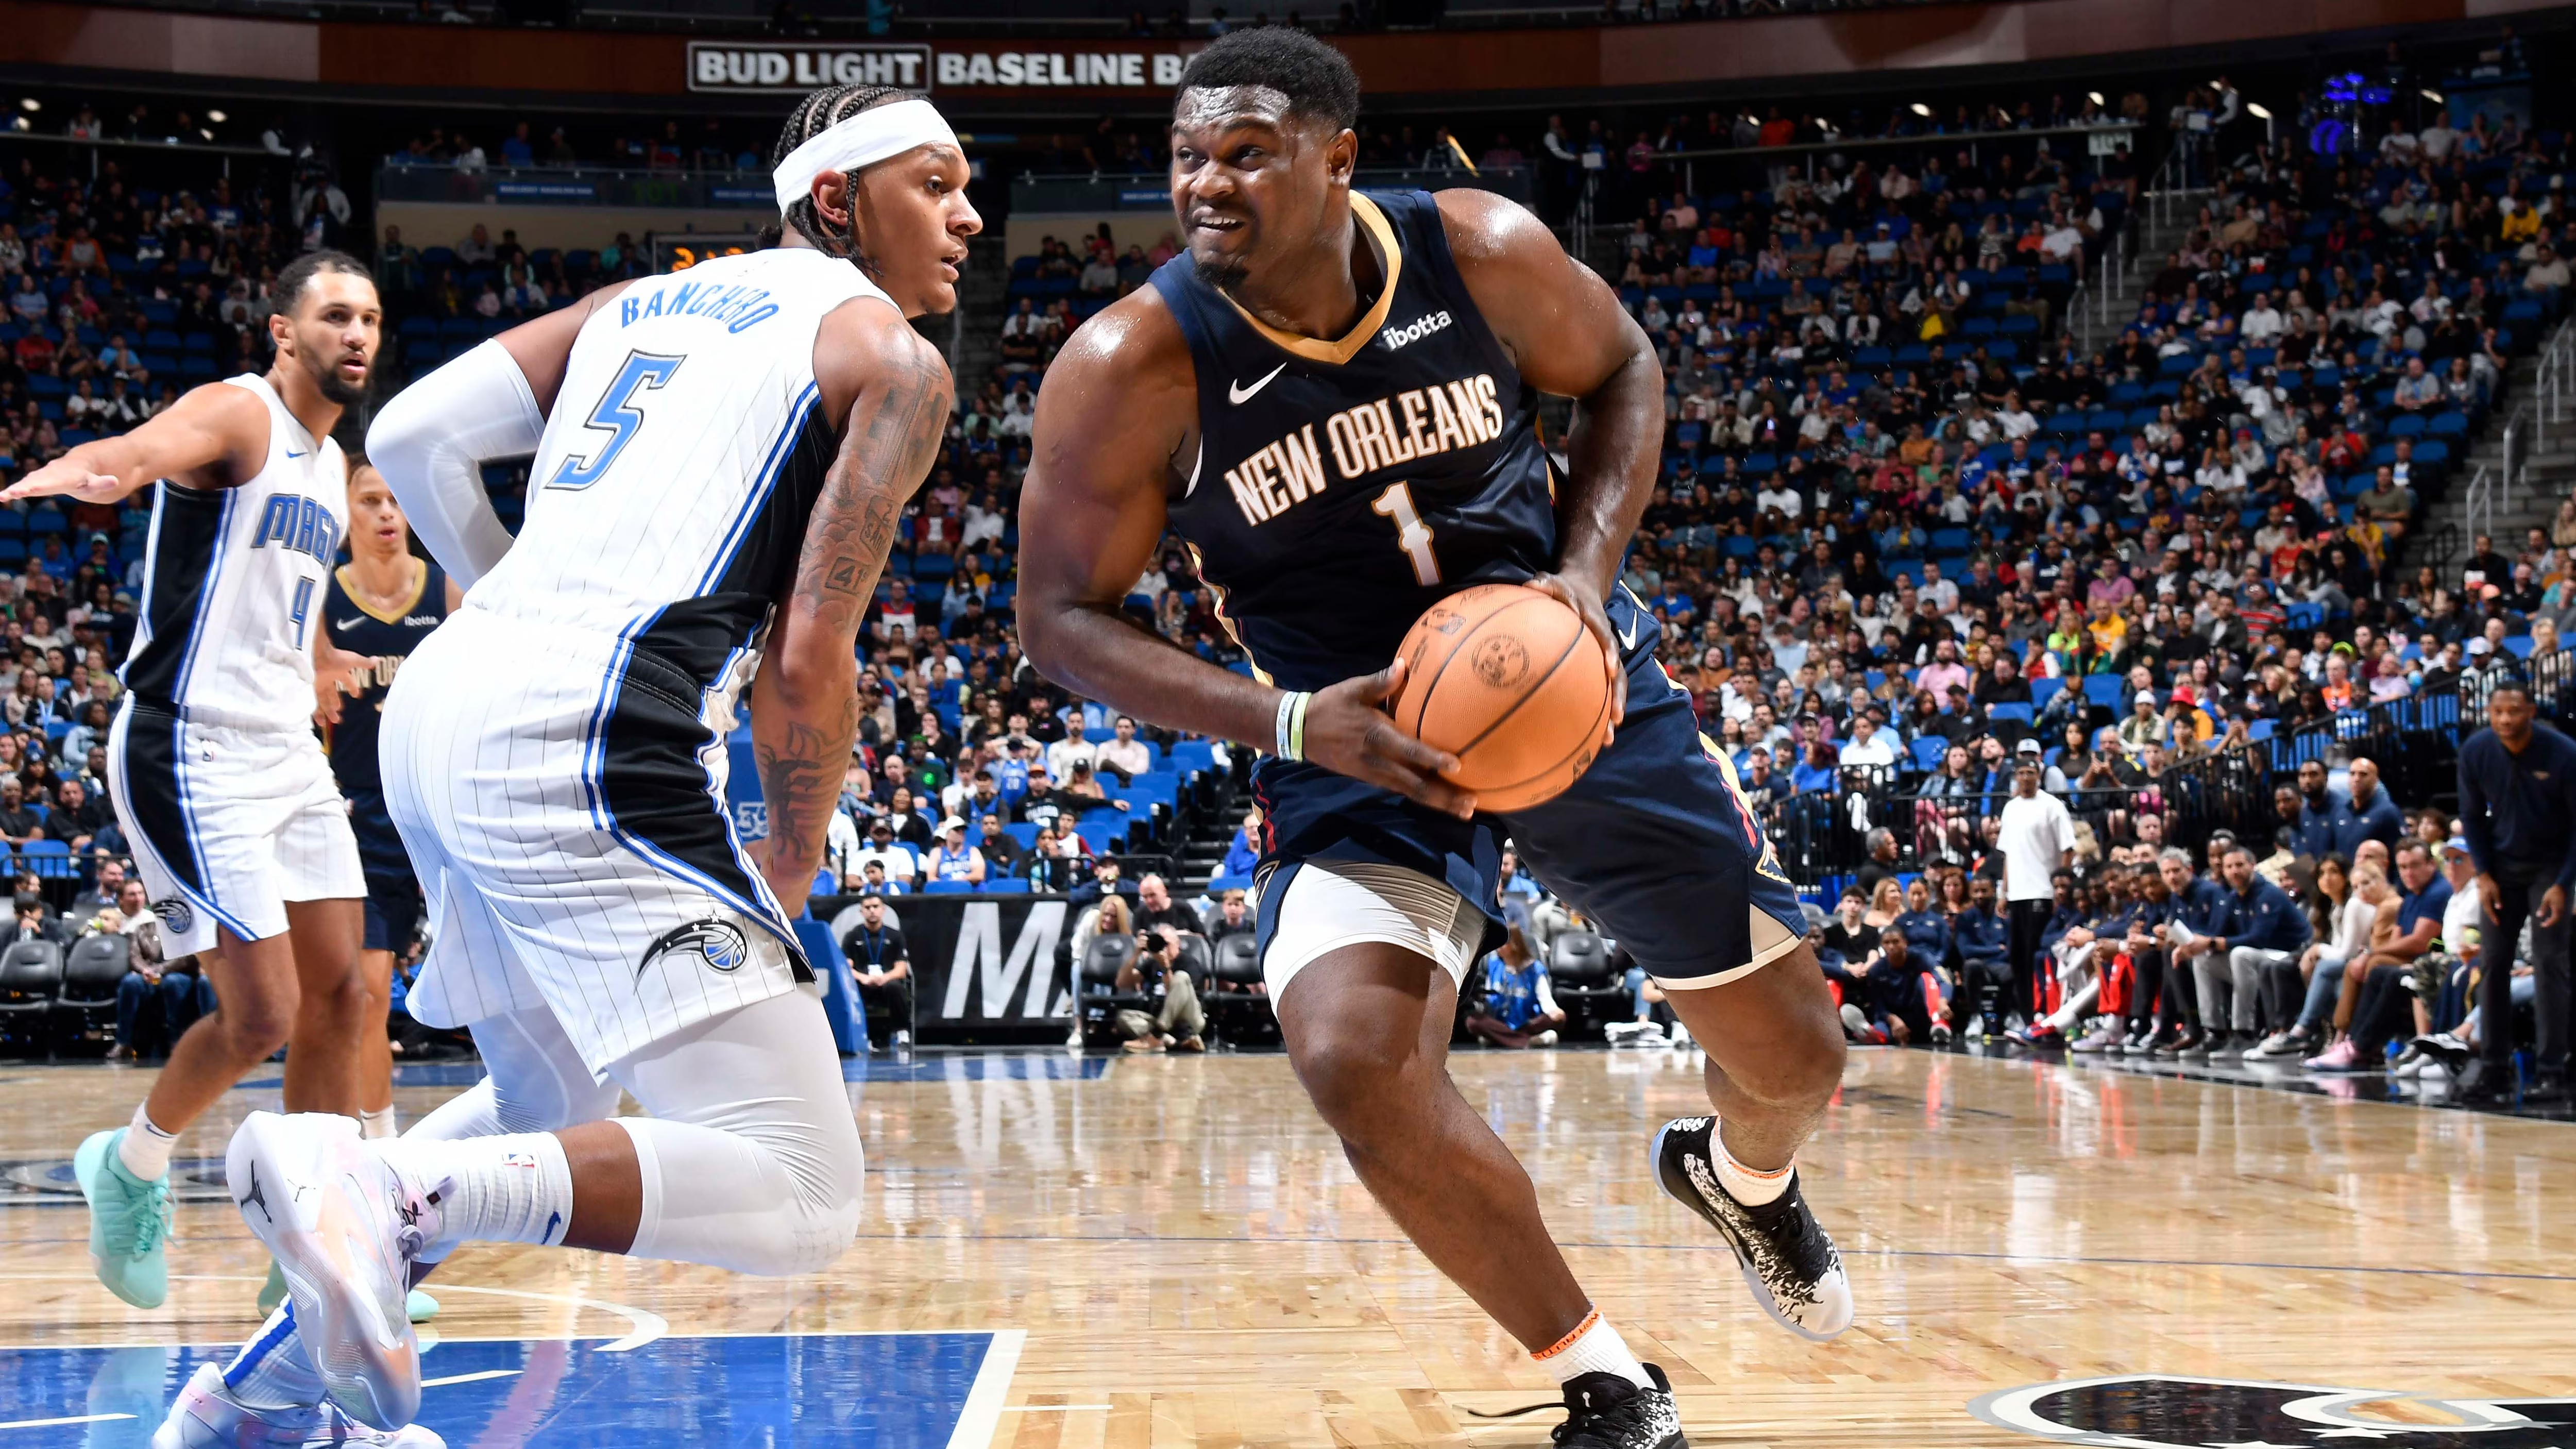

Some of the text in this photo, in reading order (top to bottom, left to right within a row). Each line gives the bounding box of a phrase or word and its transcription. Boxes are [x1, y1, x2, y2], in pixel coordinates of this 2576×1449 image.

[696, 50, 922, 85] BUD LIGHT
[937, 53, 1196, 86] BASELINE B
[621, 282, 779, 334] BANCHERO
[1382, 310, 1452, 352] ibotta
[544, 348, 687, 491] 5
[1224, 374, 1504, 527] NEW ORLEANS
[250, 493, 340, 569] MAGI
[1370, 480, 1443, 586] 1
[290, 575, 315, 650] 4
